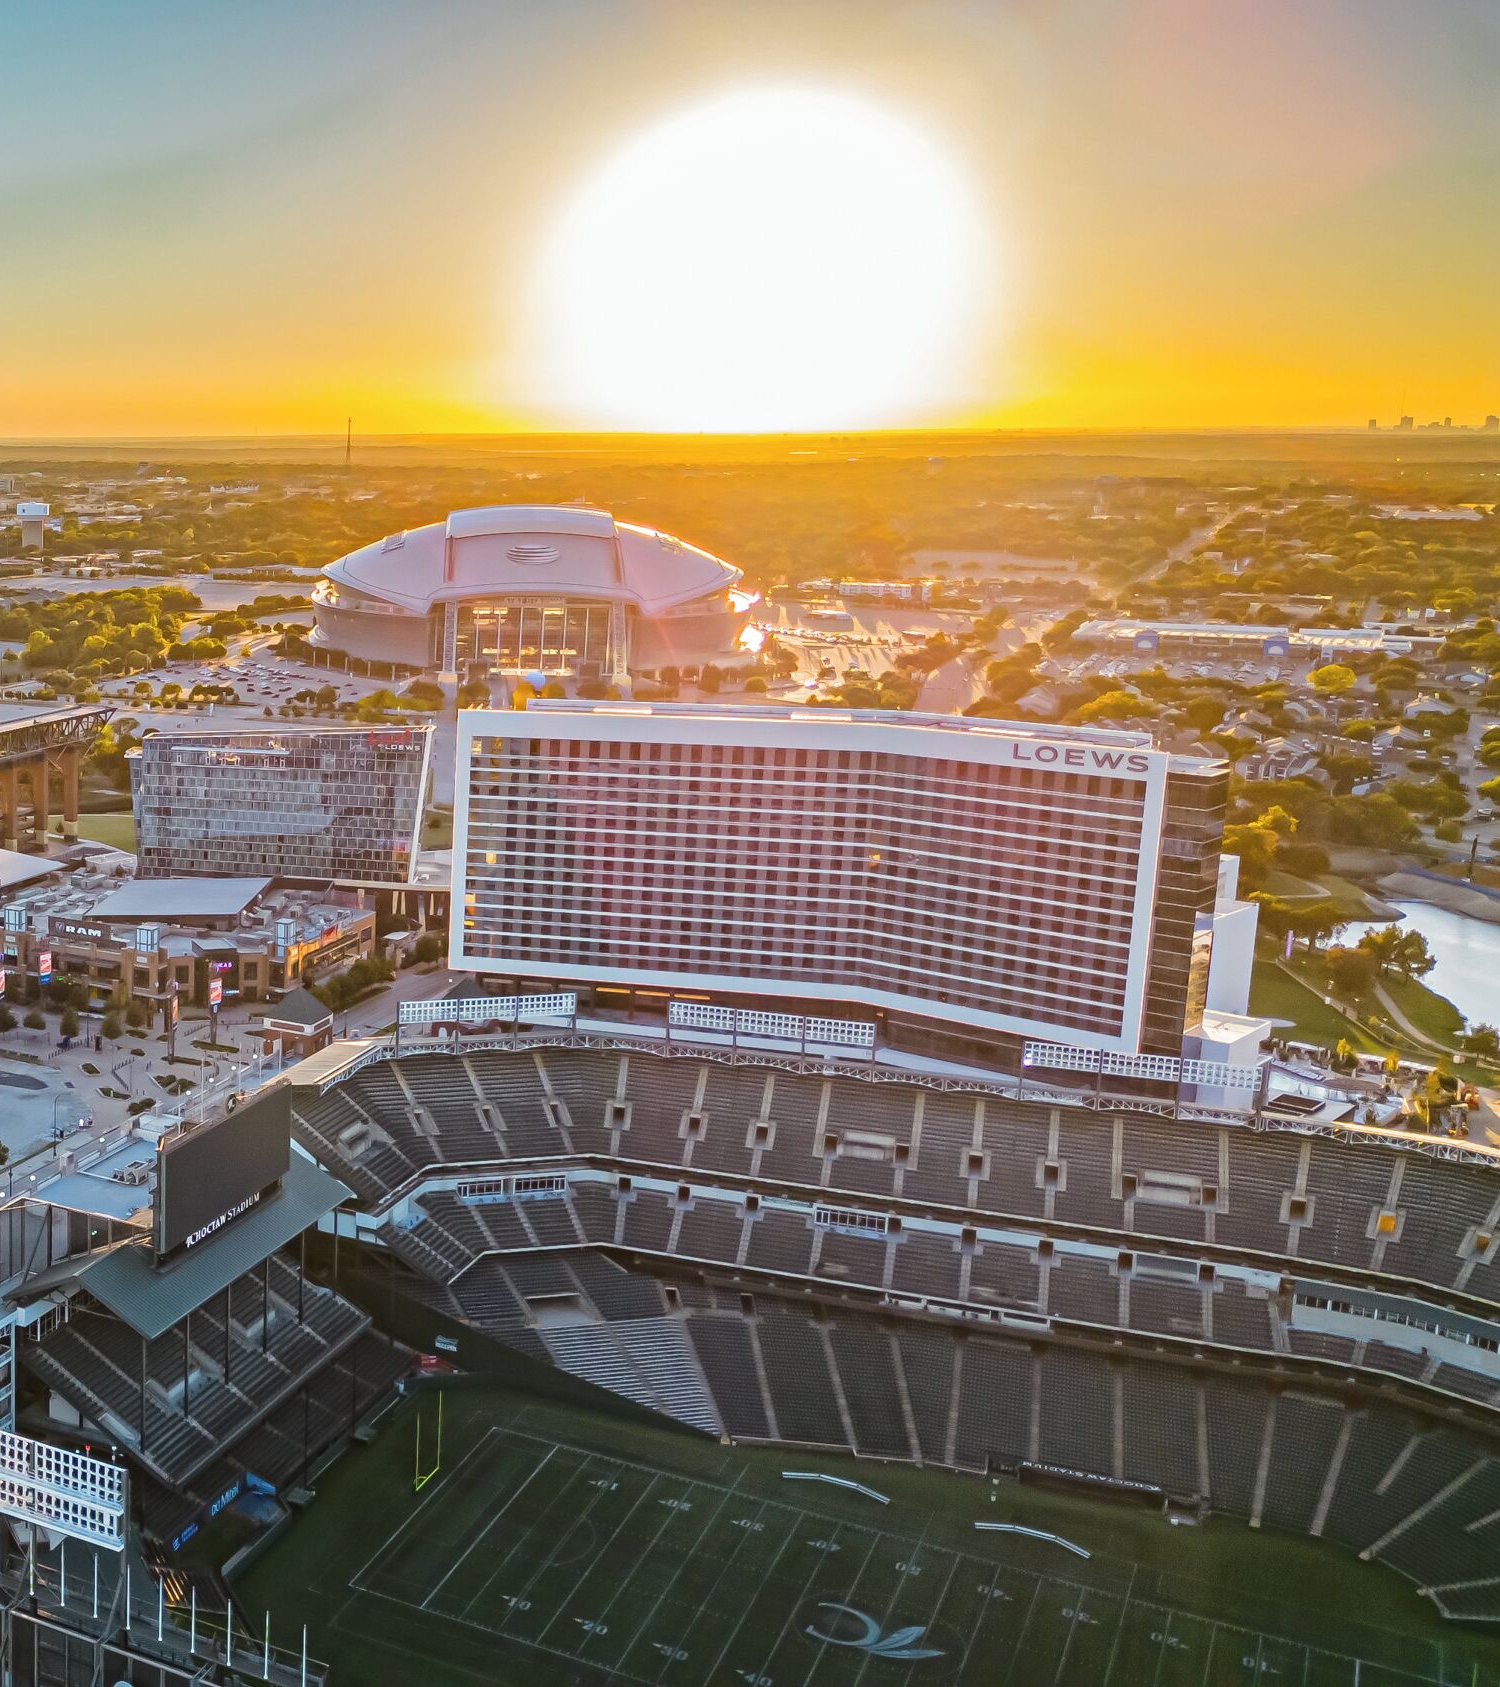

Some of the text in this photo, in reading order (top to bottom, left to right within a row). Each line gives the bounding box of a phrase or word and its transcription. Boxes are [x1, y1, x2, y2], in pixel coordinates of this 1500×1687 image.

[384, 744, 420, 752] LOEWS
[1012, 743, 1149, 773] LOEWS
[65, 925, 102, 937] RAM
[189, 1191, 260, 1245] CHOCTAW STADIUM
[507, 1595, 532, 1611] 10
[581, 1620, 608, 1635] 20
[659, 1645, 689, 1661] 30
[743, 1672, 773, 1687] 40
